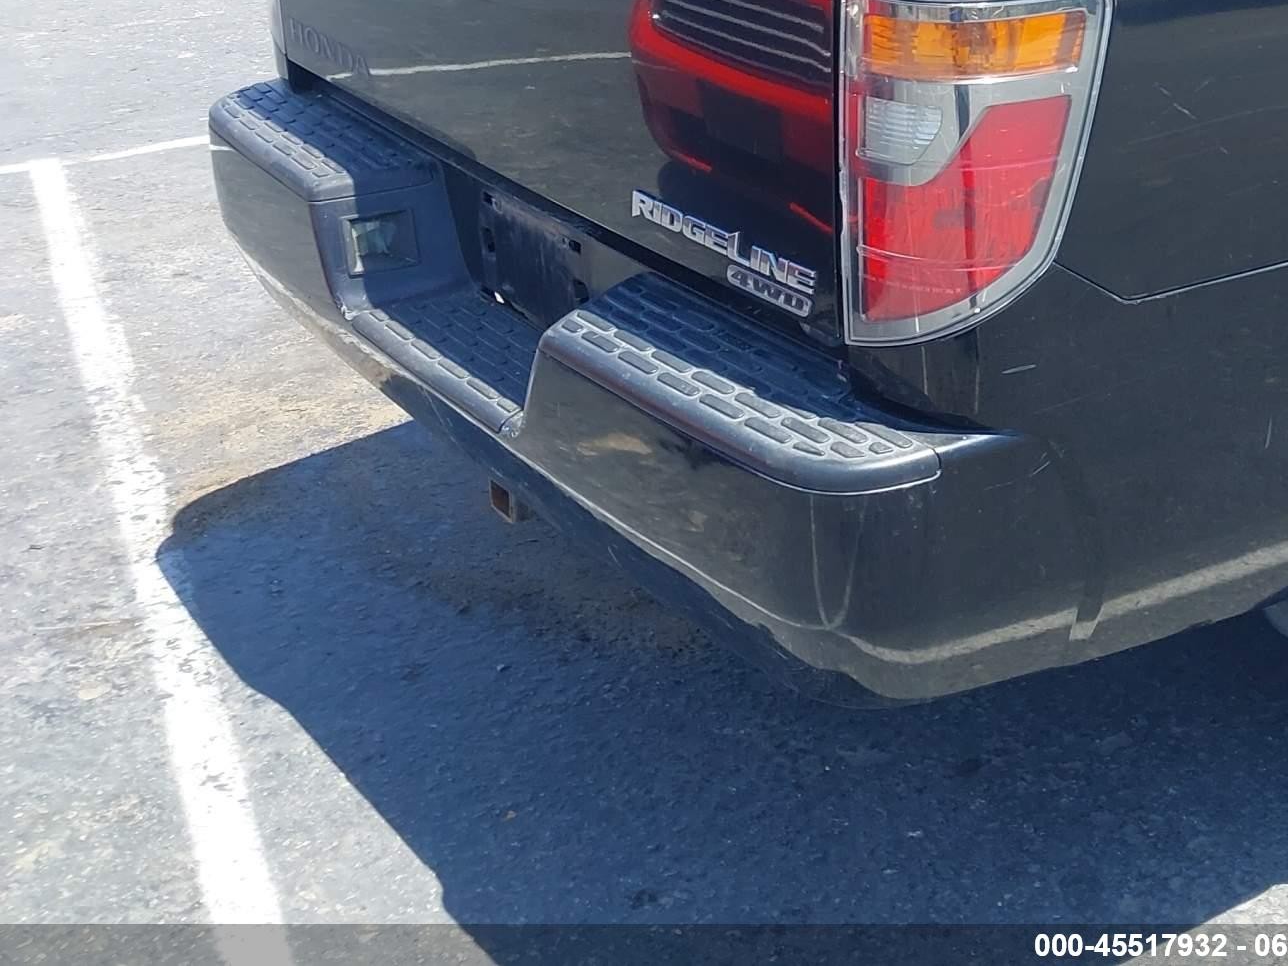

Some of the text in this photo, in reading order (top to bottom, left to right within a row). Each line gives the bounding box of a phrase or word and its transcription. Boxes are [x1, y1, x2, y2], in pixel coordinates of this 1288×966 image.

[288, 17, 369, 76] HONDA
[632, 190, 816, 294] RIDGELINE
[730, 267, 812, 316] 4WD
